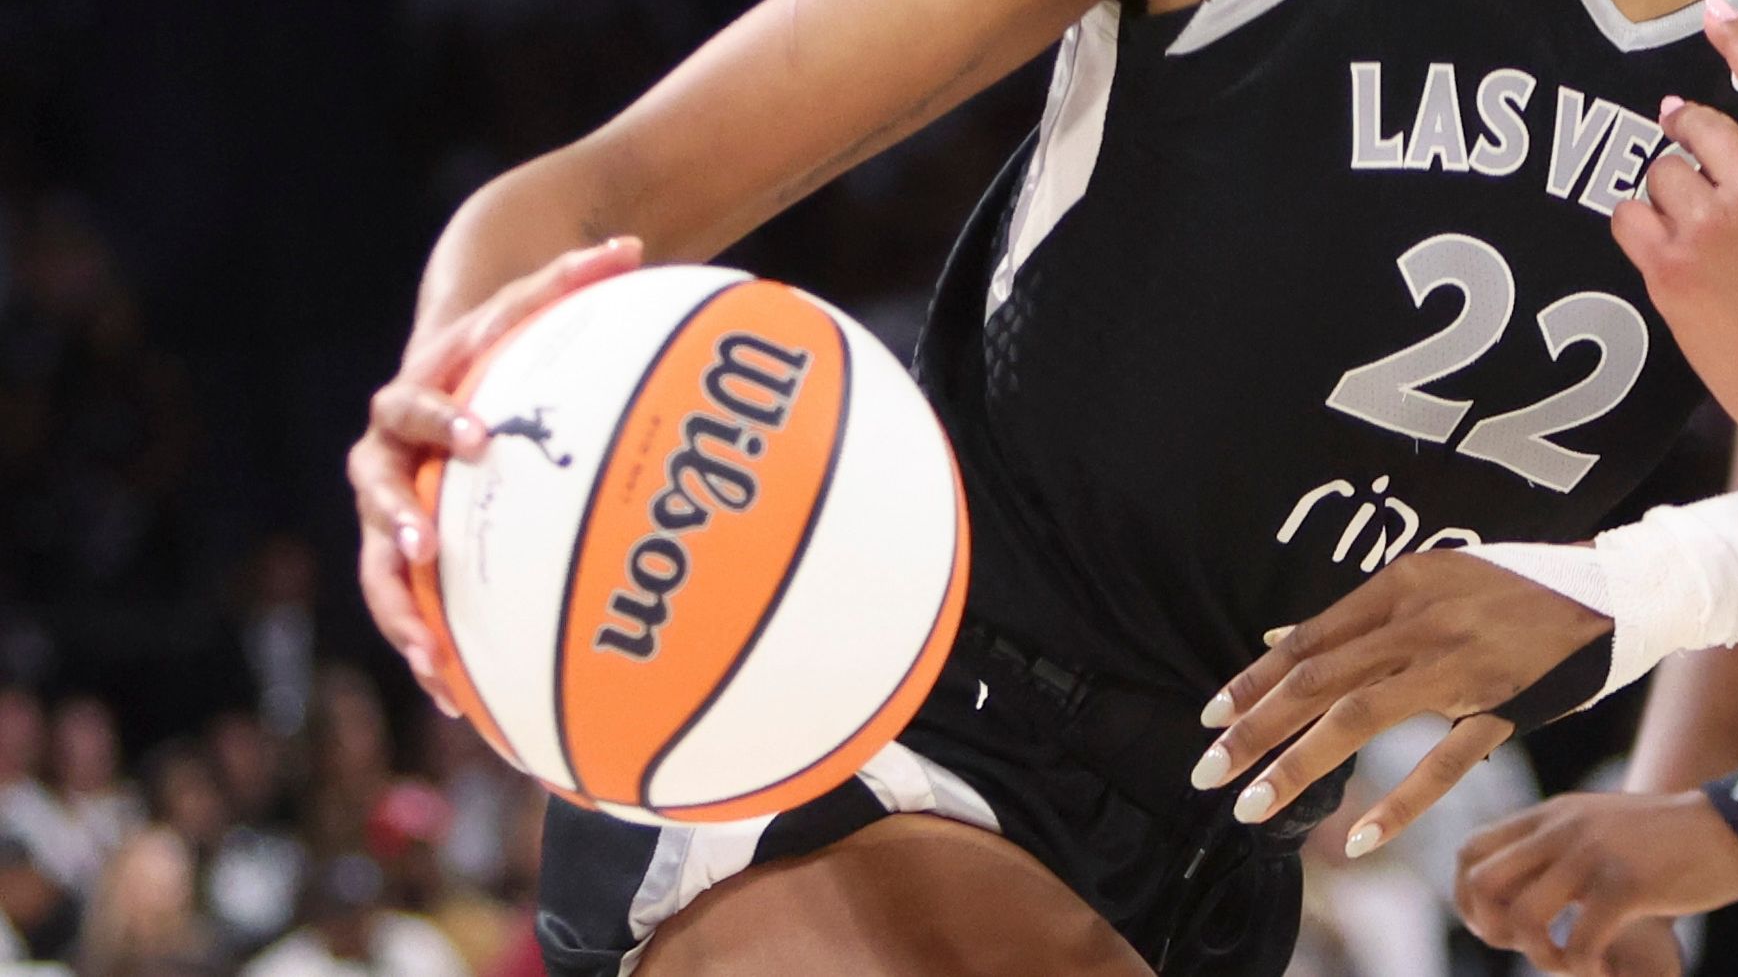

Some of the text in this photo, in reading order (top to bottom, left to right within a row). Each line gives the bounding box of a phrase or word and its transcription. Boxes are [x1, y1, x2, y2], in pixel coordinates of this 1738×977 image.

[1350, 61, 1702, 216] LAS VE
[1325, 233, 1649, 494] 22
[595, 332, 813, 661] Wilson
